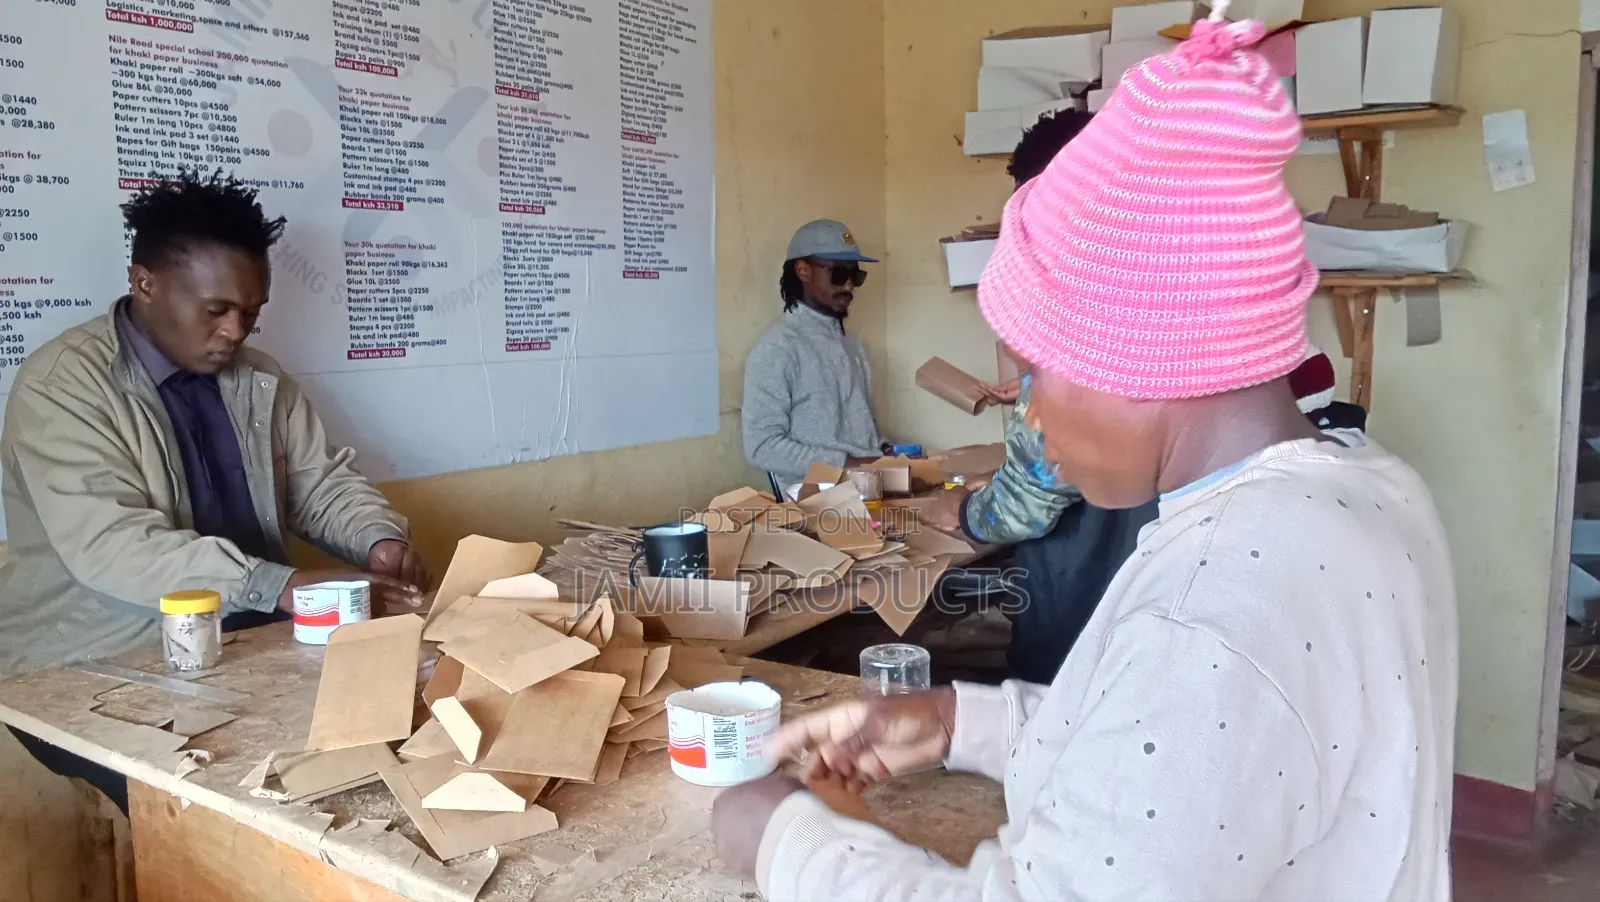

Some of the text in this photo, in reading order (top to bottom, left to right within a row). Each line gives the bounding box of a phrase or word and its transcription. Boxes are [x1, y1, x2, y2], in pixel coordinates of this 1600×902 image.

[106, 0, 144, 12] Logistics
[152, 8, 222, 26] marketing,space
[224, 20, 240, 28] and
[242, 22, 267, 33] others
[106, 9, 193, 31] Total ksh 1,000,000
[108, 33, 288, 68] Nile Road special school 200,000 quotation
[108, 44, 218, 68] for khaki paper business
[110, 56, 137, 68] Khaki
[139, 62, 166, 72] paper
[168, 65, 183, 74] roll
[246, 75, 281, 87] @54,000
[335, 59, 395, 75] Total ksh 100,000
[111, 79, 133, 89] Glue
[154, 84, 192, 96] @30,000
[137, 71, 154, 82] kgs
[156, 73, 177, 84] hard
[179, 76, 216, 89] @60,000
[2, 94, 36, 105] @1440
[112, 89, 228, 111] Paper cutters 10pcs @4500
[337, 86, 353, 94] Your
[369, 91, 400, 100] quotation
[402, 94, 411, 102] for
[113, 100, 237, 122] Pattern scissors 7pc @10,500
[12, 118, 55, 129] @28,380
[114, 112, 236, 132] Ruler 1m long 10pcs @4800
[115, 123, 239, 143] Ink and ink pad 3 set @1440
[340, 133, 361, 142] Paper
[362, 136, 384, 144] cutters
[402, 140, 424, 148] @2250
[116, 134, 270, 156] Ropes for Gift bags 150pairs @4500
[27, 151, 41, 160] for
[116, 145, 241, 164] Branding ink 10kgs @12,000
[150, 159, 174, 170] 10pcs
[23, 174, 33, 184] @
[36, 175, 70, 185] 38,700
[119, 169, 144, 177] Three
[272, 180, 304, 189] @11,760
[120, 180, 141, 188] Total
[344, 190, 369, 199] Rubber
[370, 192, 390, 200] bands
[427, 196, 444, 204] @400
[344, 200, 361, 208] Total
[376, 202, 399, 211] 33,310
[3, 232, 38, 241] @1500
[360, 241, 373, 249] 30k
[375, 242, 406, 250] quotation
[407, 242, 417, 250] for
[366, 250, 395, 258] business
[345, 259, 365, 267] Khaki
[40, 276, 54, 284] for
[14, 300, 31, 309] kgs
[35, 299, 72, 308] @9,000
[75, 299, 91, 307] ksh
[24, 311, 41, 319] ksh
[350, 350, 367, 358] Total
[381, 349, 403, 358] 30,000
